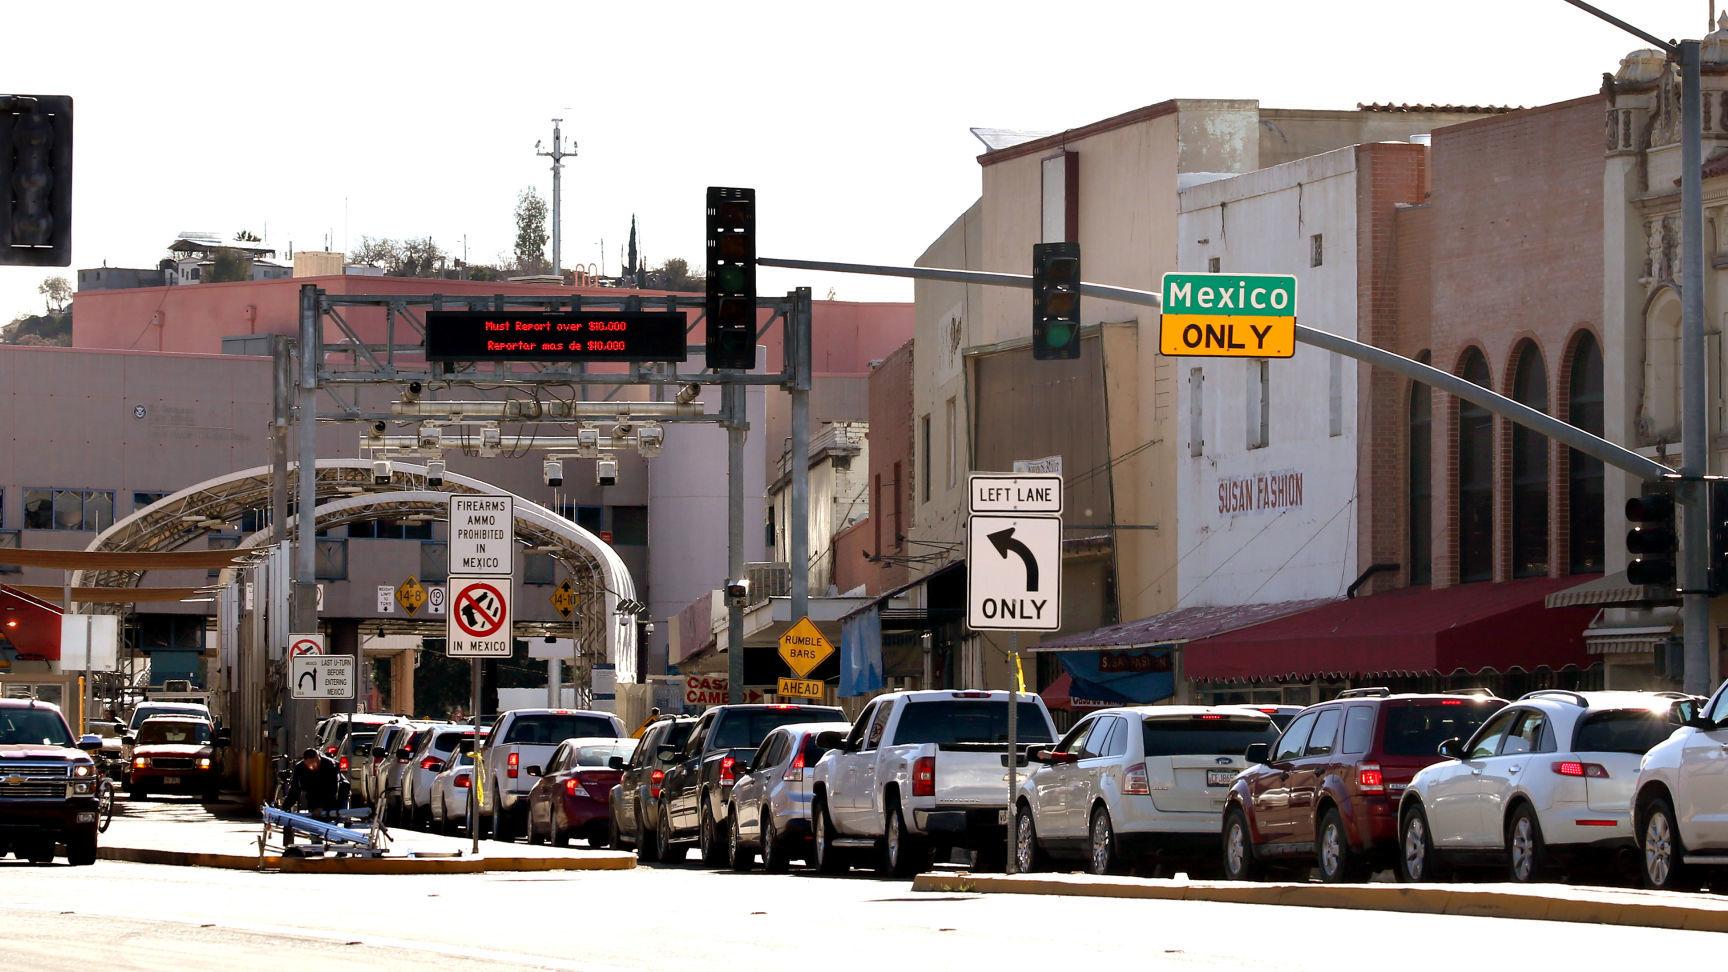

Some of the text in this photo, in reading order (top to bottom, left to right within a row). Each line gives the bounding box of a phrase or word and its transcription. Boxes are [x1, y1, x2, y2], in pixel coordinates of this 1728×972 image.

[1169, 281, 1288, 309] Mexico
[485, 321, 510, 331] Must
[515, 321, 551, 332] Report
[556, 323, 582, 331] over
[1182, 323, 1273, 349] ONLY
[487, 341, 536, 351] Reportar
[542, 343, 564, 351] mas
[568, 341, 582, 351] de
[980, 487, 1052, 502] LEFT LANE
[1218, 473, 1303, 513] SUSAN FASHION
[457, 501, 506, 511] FIREARMS
[467, 515, 496, 525] AMMO
[458, 529, 504, 540] PROHIBITED
[476, 543, 486, 553] IN
[463, 557, 499, 568] MEXICO
[433, 591, 441, 599] 10
[982, 598, 1047, 620] ONLY
[453, 641, 463, 651] IN
[470, 641, 506, 651] MEXICO
[785, 635, 822, 647] RUMBLE
[790, 649, 816, 659] BARS
[321, 659, 351, 667] LAST U-TURN
[327, 668, 345, 676] BEFORE
[325, 678, 347, 686] ENTERING
[327, 688, 345, 696] MEXICO
[782, 682, 819, 695] AHEAD
